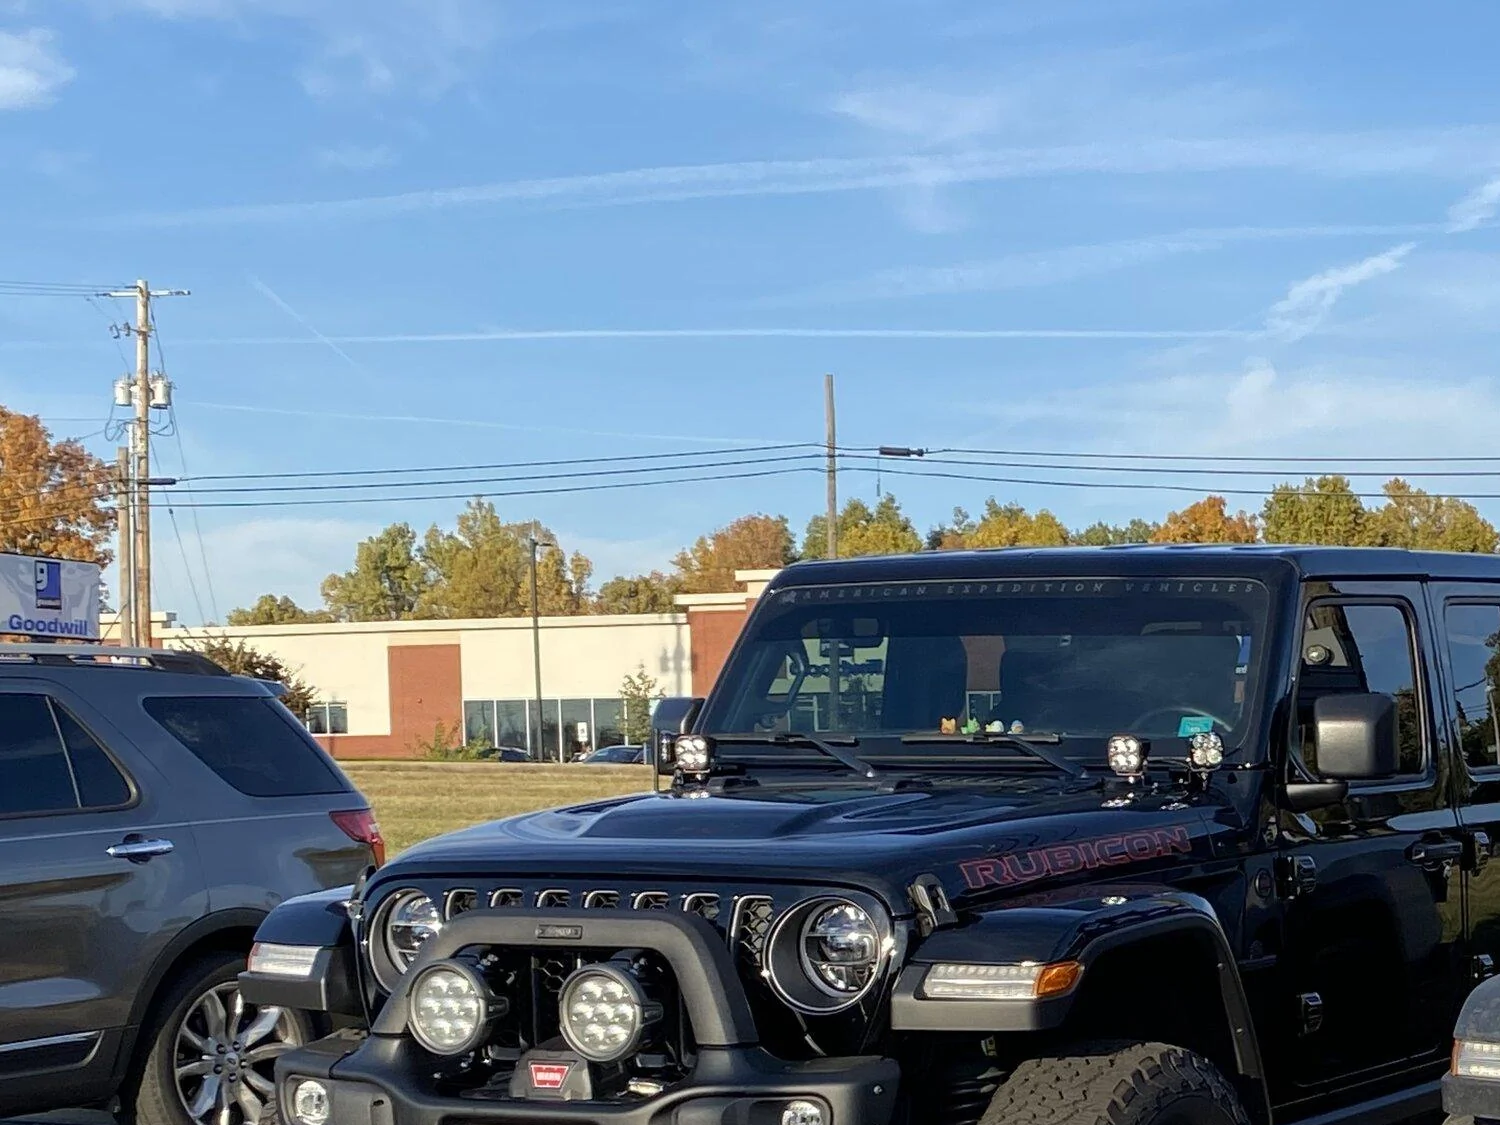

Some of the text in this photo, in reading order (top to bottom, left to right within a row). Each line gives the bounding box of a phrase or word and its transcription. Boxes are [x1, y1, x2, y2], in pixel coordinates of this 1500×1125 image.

[802, 583, 1253, 599] AMERICAN EXPEDITION VEHICLES
[9, 614, 88, 636] Goodwill
[959, 825, 1193, 889] RUBICON
